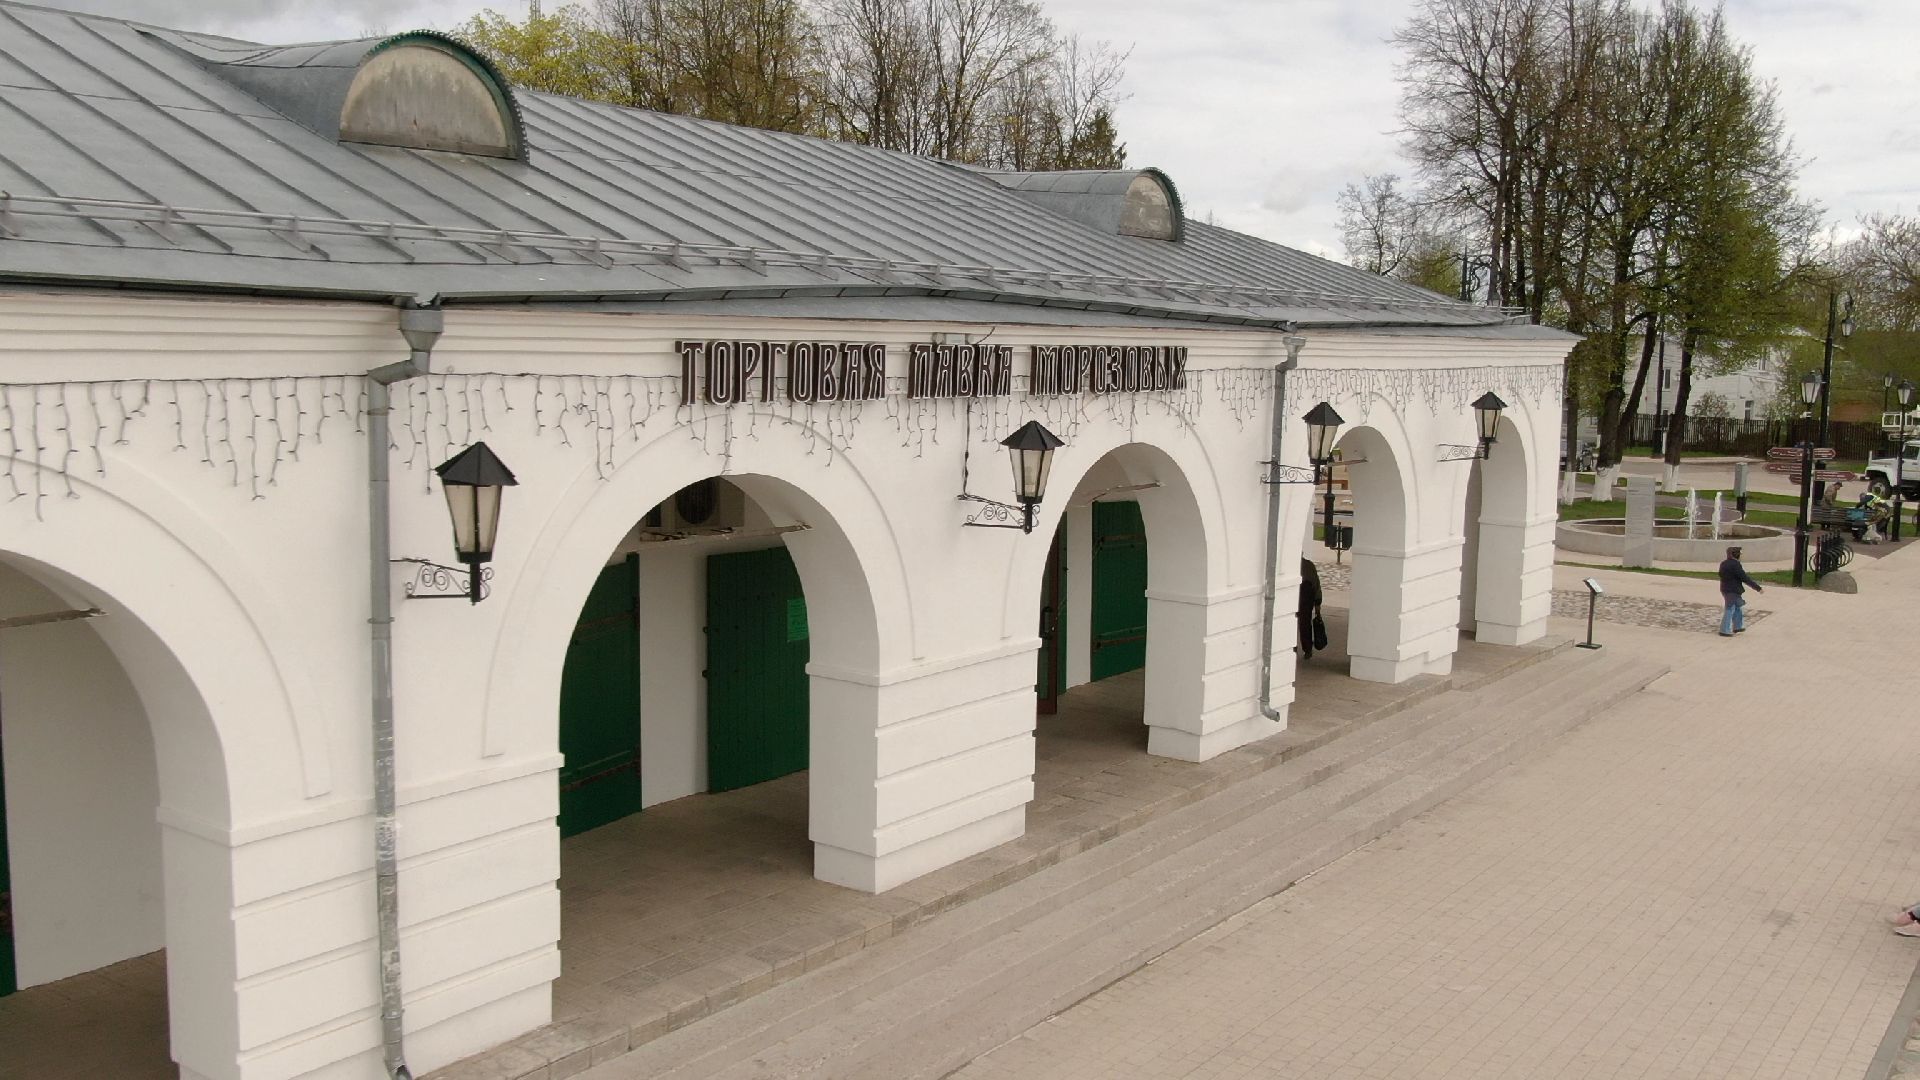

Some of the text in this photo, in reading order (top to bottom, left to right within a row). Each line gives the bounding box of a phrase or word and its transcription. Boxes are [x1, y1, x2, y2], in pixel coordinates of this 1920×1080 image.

[675, 341, 1189, 405] ТОРГОВАЯ ЛАВКА МОРОЗОВЫХ
